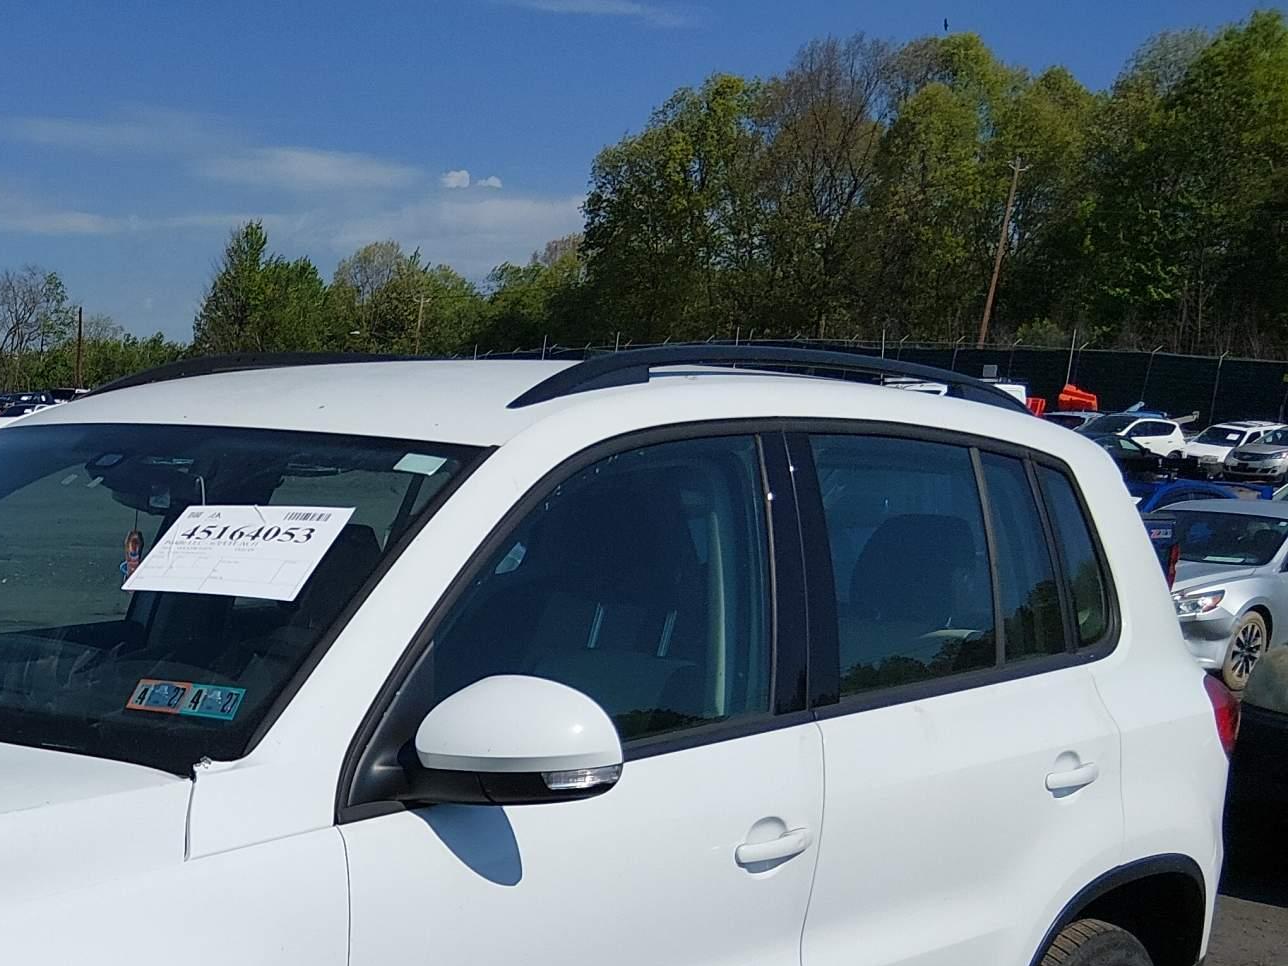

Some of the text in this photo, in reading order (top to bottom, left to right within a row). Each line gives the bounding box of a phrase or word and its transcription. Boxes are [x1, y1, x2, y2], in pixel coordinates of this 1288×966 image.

[181, 525, 316, 543] 45164053
[136, 687, 149, 705] 4
[188, 689, 202, 710] 4
